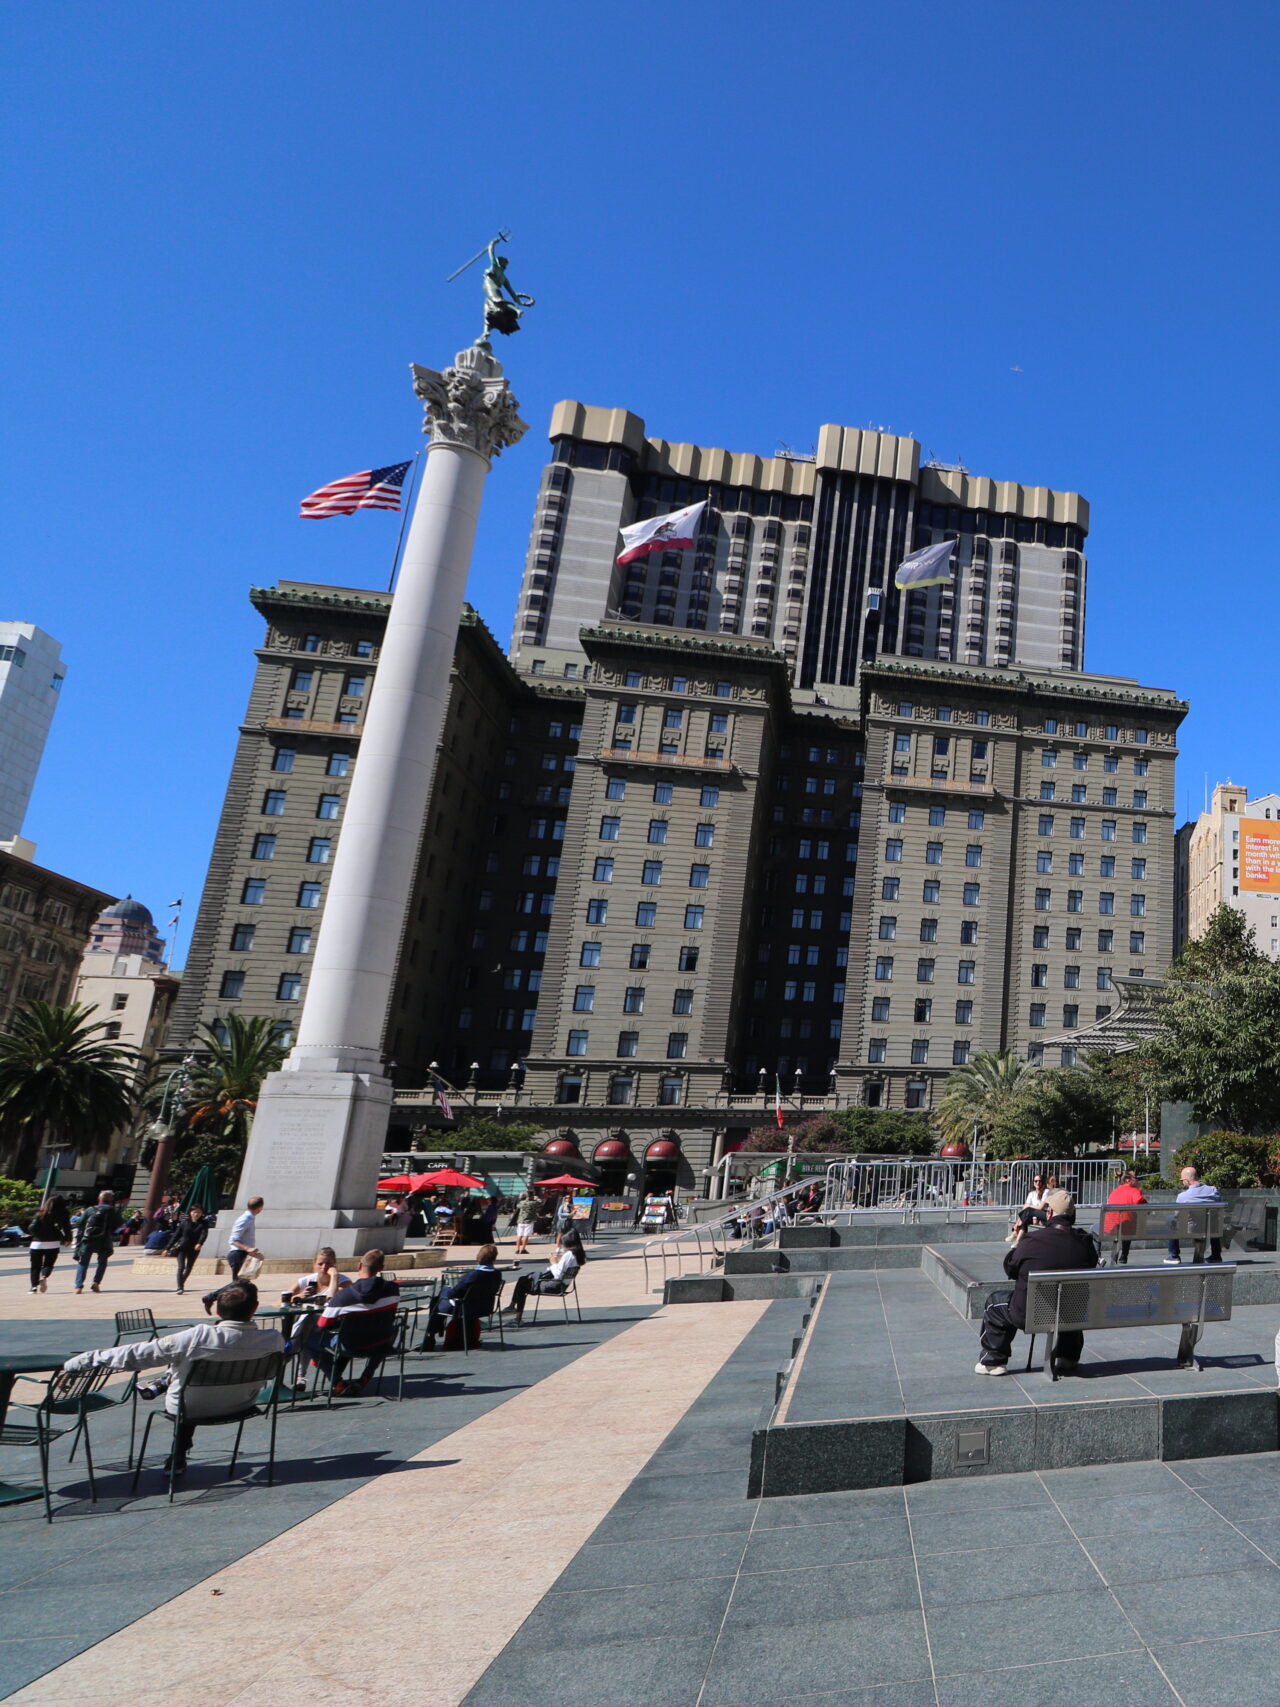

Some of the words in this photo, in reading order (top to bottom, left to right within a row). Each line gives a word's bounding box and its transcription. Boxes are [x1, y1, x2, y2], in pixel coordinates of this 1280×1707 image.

[1245, 835, 1261, 843] Earn
[1245, 843, 1271, 851] interest
[1262, 865, 1274, 873] the
[1245, 871, 1269, 880] banks.
[802, 1164, 814, 1173] BIKE
